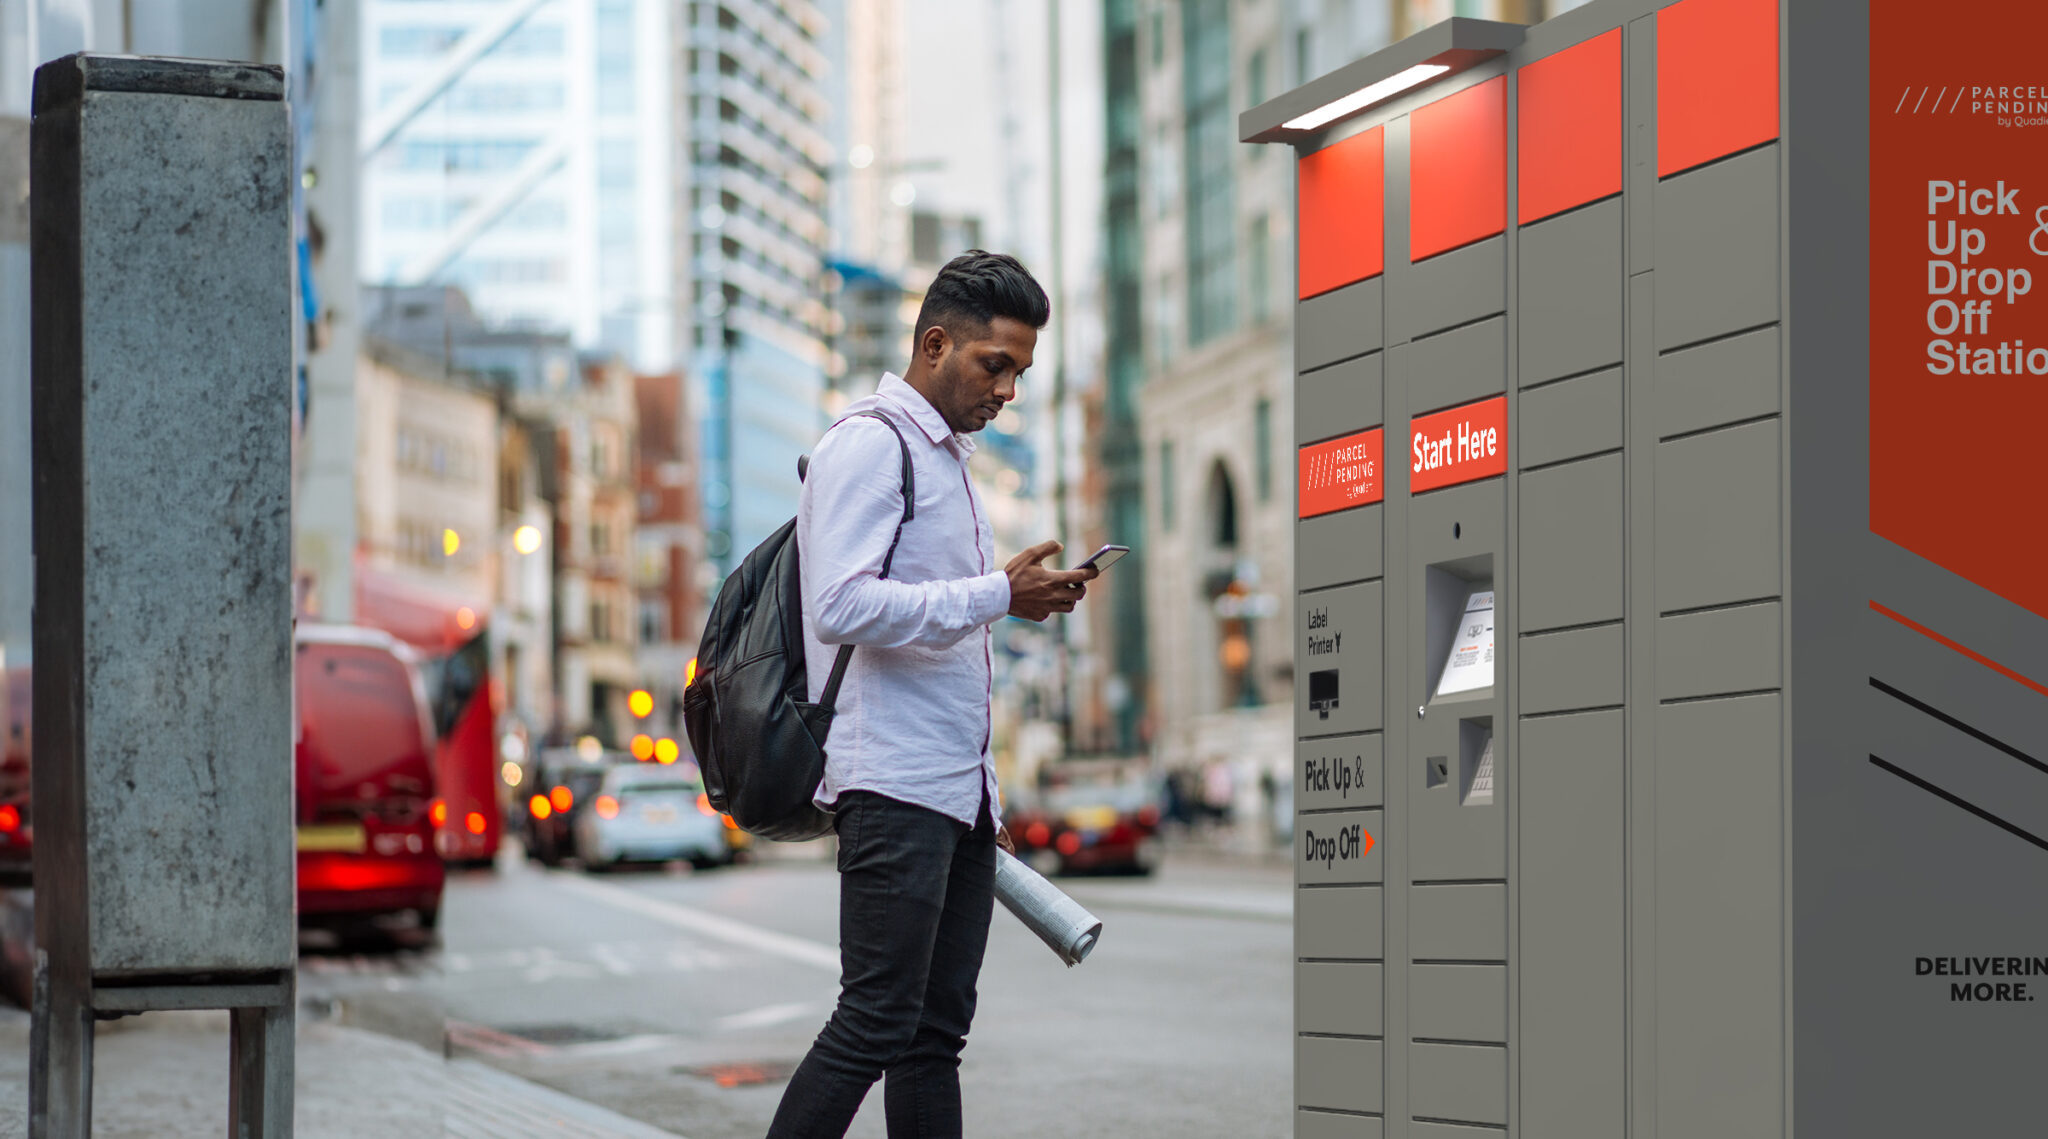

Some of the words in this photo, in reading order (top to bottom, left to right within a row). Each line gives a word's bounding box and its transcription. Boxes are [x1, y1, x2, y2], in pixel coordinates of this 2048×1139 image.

[1971, 86, 2048, 99] PARCEL
[1971, 101, 2048, 114] PENDIN
[1997, 116, 2012, 128] by
[1927, 180, 2021, 215] Pick
[1927, 220, 1986, 264] Up
[1927, 260, 2032, 304] Drop
[1926, 299, 1992, 335] Off
[1926, 339, 2048, 376] Statio
[1336, 443, 1367, 465] PARCEL
[1413, 430, 1453, 473] Start
[1457, 421, 1497, 462] Here
[1336, 460, 1375, 484] PENDING
[1308, 606, 1328, 629] Label
[1308, 634, 1334, 656] Printer
[1305, 758, 1330, 792] Pick
[1333, 757, 1351, 799] Up
[1354, 755, 1365, 789] &
[1305, 829, 1336, 870] Drop
[1339, 824, 1361, 860] Off
[1915, 957, 2048, 976] DELIVERIN
[1951, 983, 2035, 1002] MORE.
